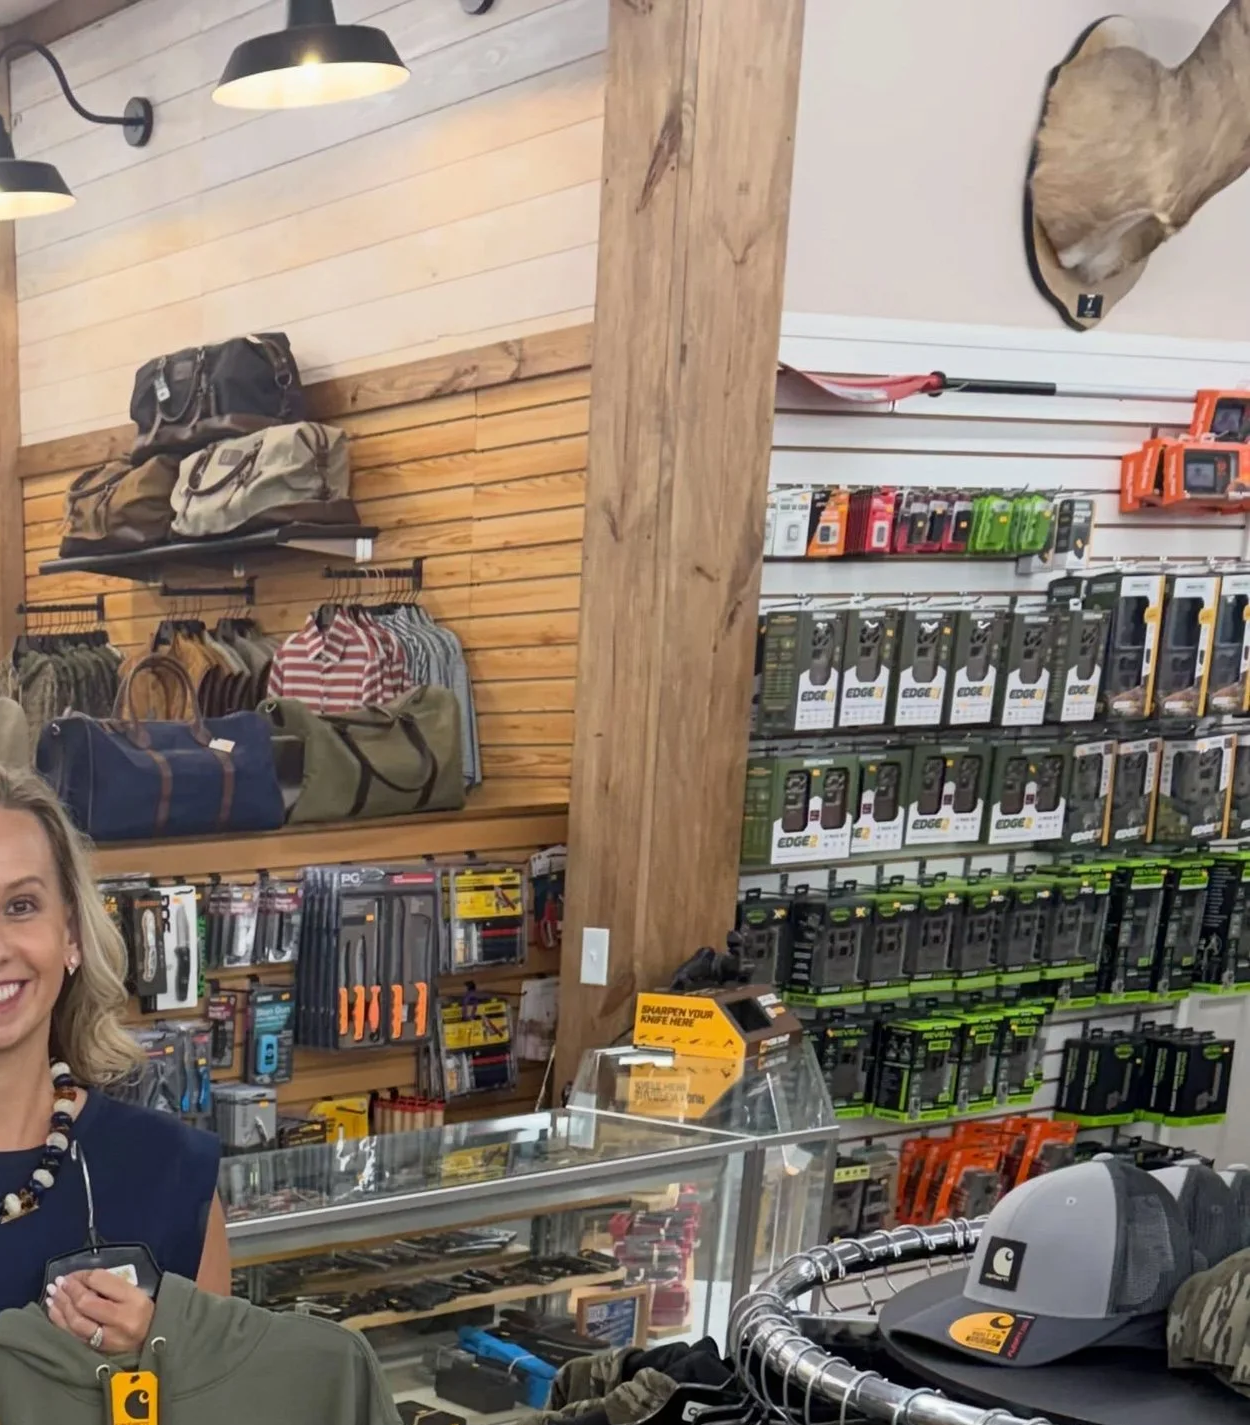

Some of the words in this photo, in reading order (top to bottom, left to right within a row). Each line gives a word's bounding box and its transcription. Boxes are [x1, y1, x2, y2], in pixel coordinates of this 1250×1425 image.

[912, 816, 950, 832] EDGE2
[995, 816, 1034, 831] EDGE2
[777, 833, 819, 849] EDGE2
[641, 1005, 687, 1017] SHARPEN
[688, 1009, 714, 1020] YOUR
[640, 1014, 669, 1026] KNIFE
[670, 1018, 695, 1028] HERE
